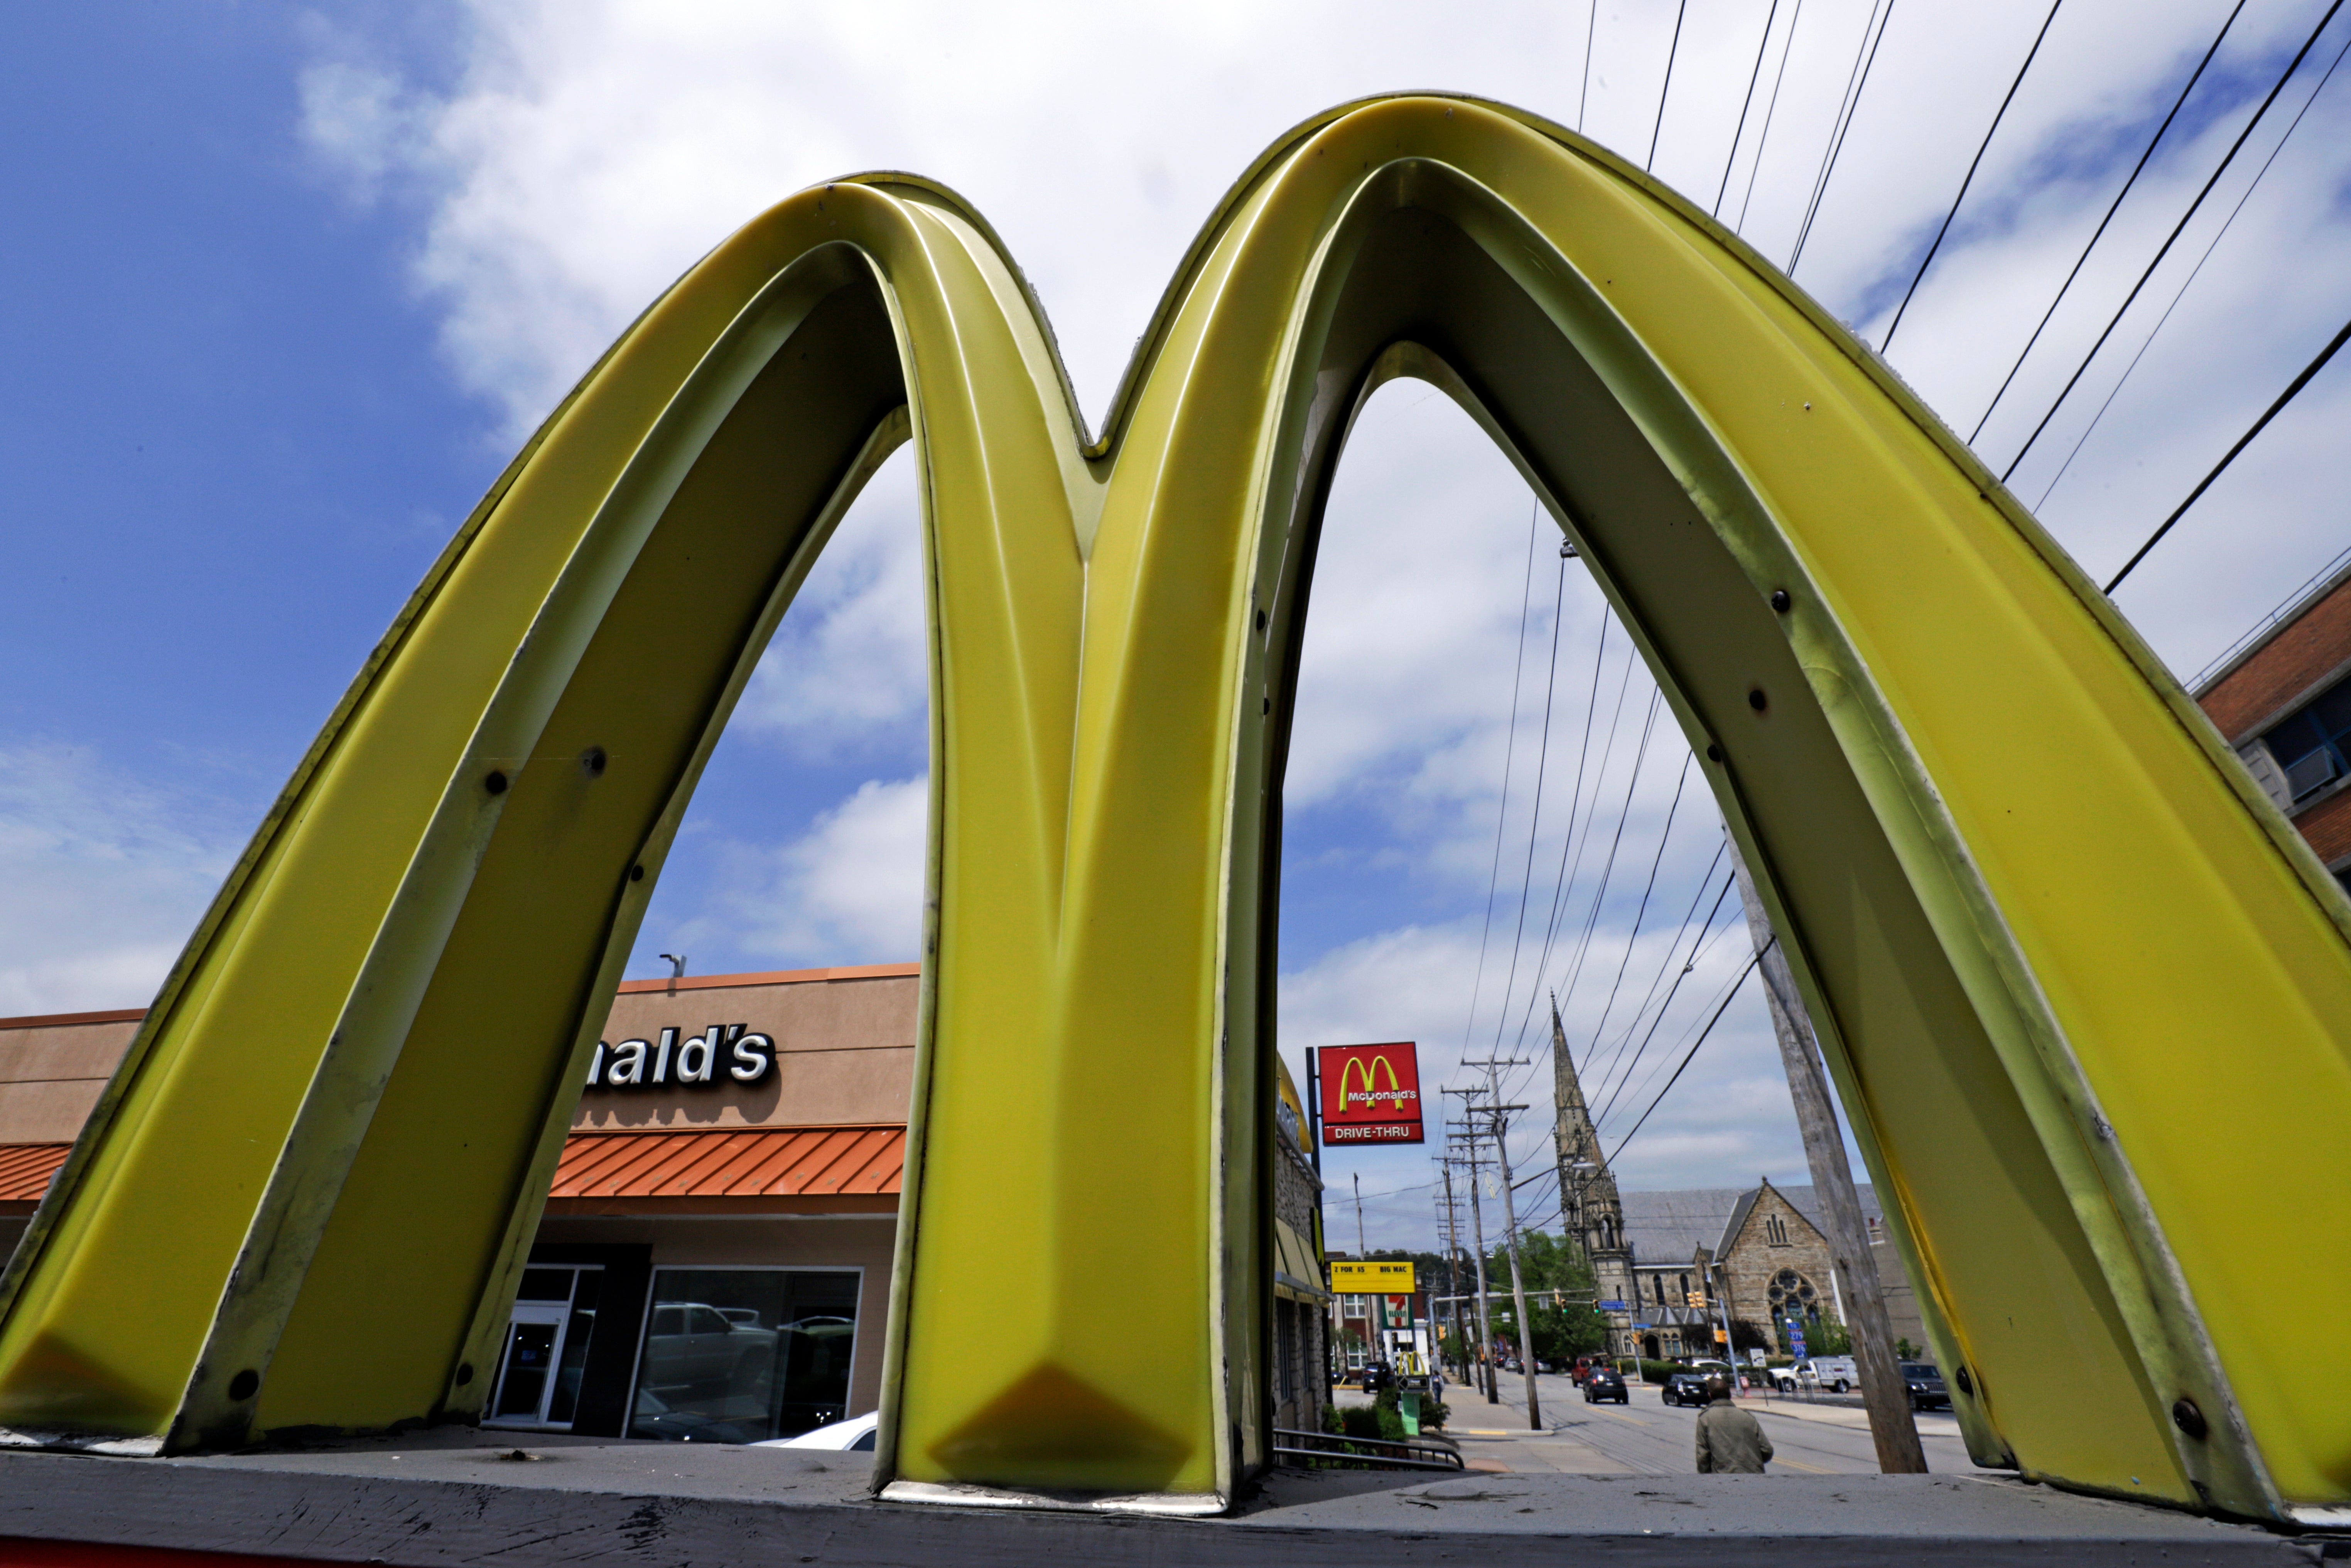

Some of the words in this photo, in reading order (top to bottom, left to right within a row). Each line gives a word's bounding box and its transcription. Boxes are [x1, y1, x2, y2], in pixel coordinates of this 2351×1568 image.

[1348, 1090, 1417, 1101] McDonald's
[1335, 1126, 1409, 1139] DRIVE-THRU
[1791, 1331, 1803, 1340] 279
